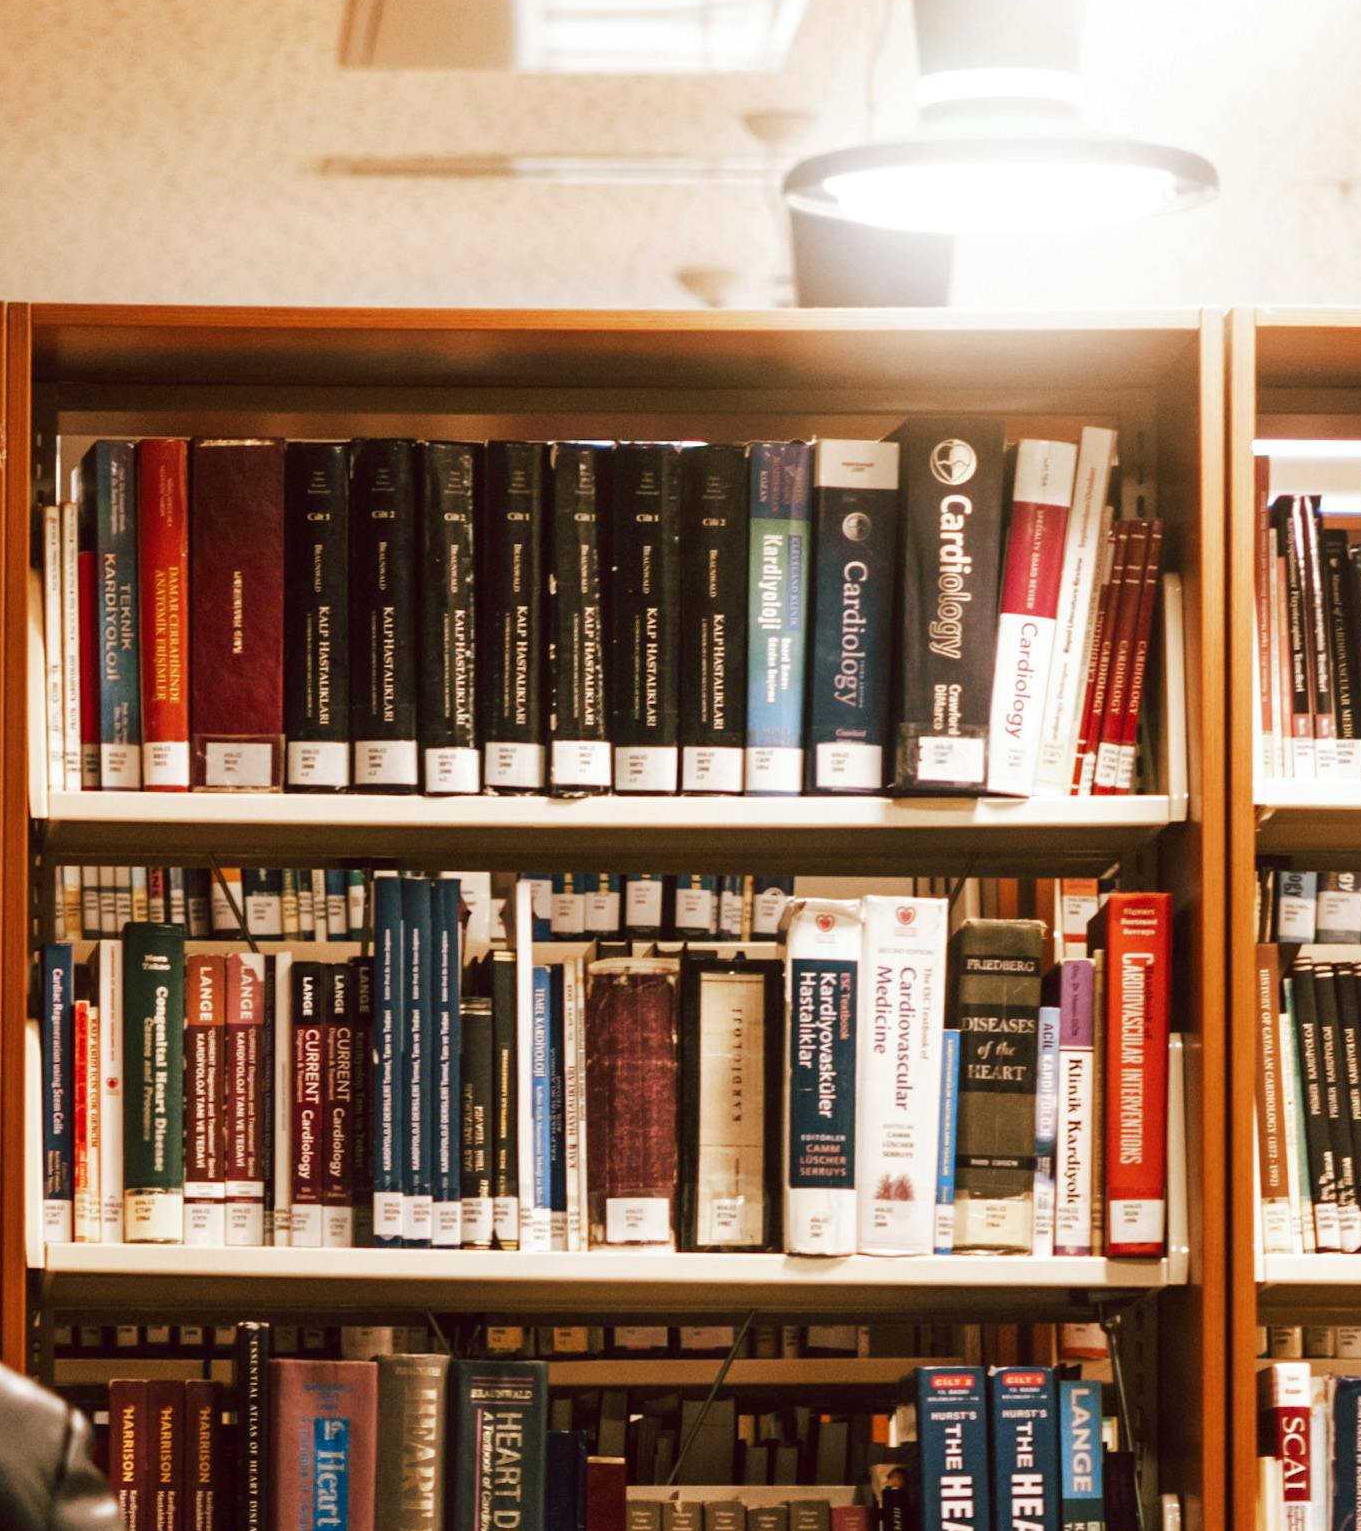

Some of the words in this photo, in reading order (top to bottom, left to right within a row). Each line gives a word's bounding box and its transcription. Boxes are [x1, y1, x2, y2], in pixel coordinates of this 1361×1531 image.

[168, 566, 179, 610] DAMAR
[929, 495, 973, 659] Cardiology
[319, 606, 330, 636] KALP
[834, 561, 869, 708] Cardiology
[169, 614, 181, 704] CERRAHİSİNDE
[1004, 622, 1039, 739] Cardiology
[319, 641, 330, 725] HASTALIKLARI
[51, 968, 63, 1002] Cardiac
[966, 959, 1035, 973] FRIEDBERG
[1260, 969, 1272, 1010] HISTORY
[199, 966, 214, 1022] LANGE
[303, 976, 314, 1016] LANGE
[334, 975, 345, 1014] LANGE
[873, 965, 893, 1055] Medicine
[51, 1003, 64, 1062] Regeneration
[798, 971, 817, 1069] Hastalıklar
[895, 966, 917, 1111] Cardiovascular
[961, 1017, 1036, 1034] DISEASES
[1261, 1012, 1272, 1025] OF
[195, 1033, 206, 1094] KARDİYOLOJİ
[305, 1029, 321, 1104] CURRENT
[336, 1027, 352, 1102] CURRENT
[818, 972, 837, 1118] Kardiyovasküler
[1262, 1027, 1275, 1070] CATALAN
[51, 1064, 61, 1088] using
[967, 1065, 1027, 1081] HEART
[52, 1089, 63, 1111] Stem
[52, 1112, 64, 1135] Cells
[196, 1095, 205, 1117] TANI
[1265, 1071, 1278, 1132] CARDIOLOGY
[196, 1119, 205, 1132] VE
[298, 1109, 315, 1179] Cardiology
[805, 1143, 841, 1153] CAMM
[196, 1134, 206, 1169] TEDAVİ
[249, 1339, 258, 1398] ESSENTIAL
[249, 1404, 258, 1438] ATLAS
[1071, 1388, 1093, 1492] LANGE
[249, 1441, 258, 1455] OF
[495, 1412, 522, 1502] HEART
[945, 1423, 962, 1470] THE
[1016, 1421, 1033, 1469] THE
[1282, 1417, 1306, 1491] SCAI
[249, 1461, 258, 1495] HEART
[315, 1450, 345, 1527] Heart
